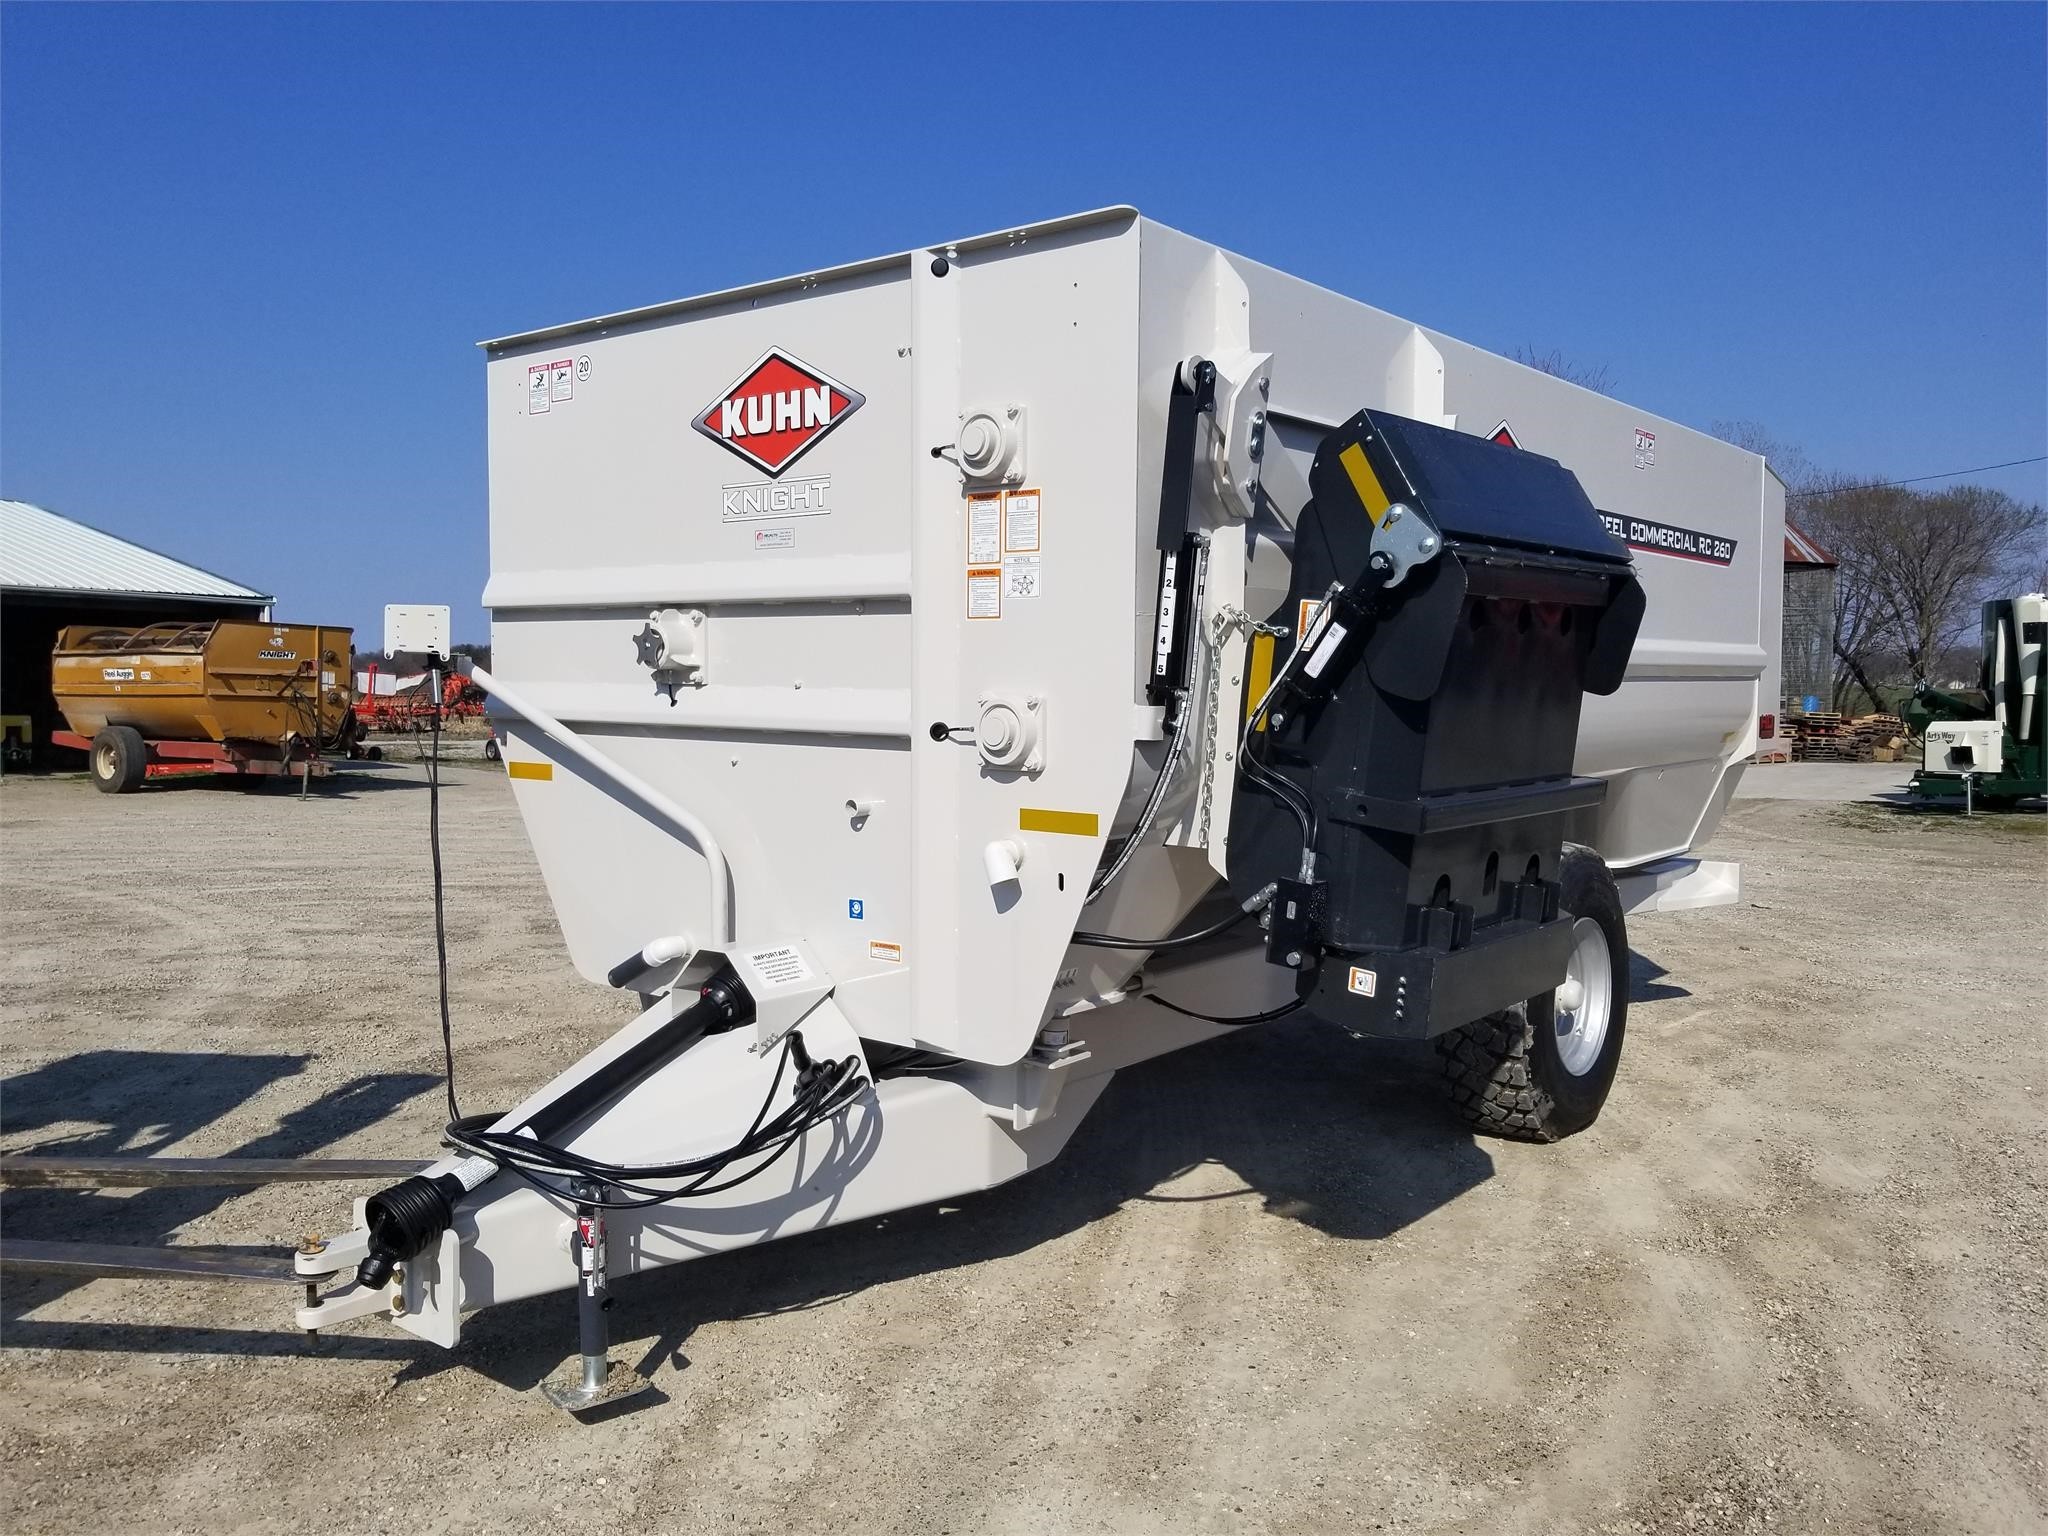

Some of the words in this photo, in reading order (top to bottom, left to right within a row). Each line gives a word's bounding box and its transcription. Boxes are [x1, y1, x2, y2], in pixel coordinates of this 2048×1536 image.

[579, 361, 589, 373] 20
[722, 385, 831, 438] KUHN
[722, 482, 830, 515] KNIGHT
[1630, 522, 1696, 552] COMMERCIAL
[1698, 537, 1711, 555] RC
[1714, 541, 1730, 559] 260
[1166, 579, 1172, 588] 2
[1163, 607, 1169, 616] 3
[1160, 636, 1166, 645] 4
[260, 651, 295, 659] KNIGHT
[1157, 664, 1164, 673] 5
[1942, 732, 1955, 740] Way
[752, 949, 791, 961] IMPORTANT
